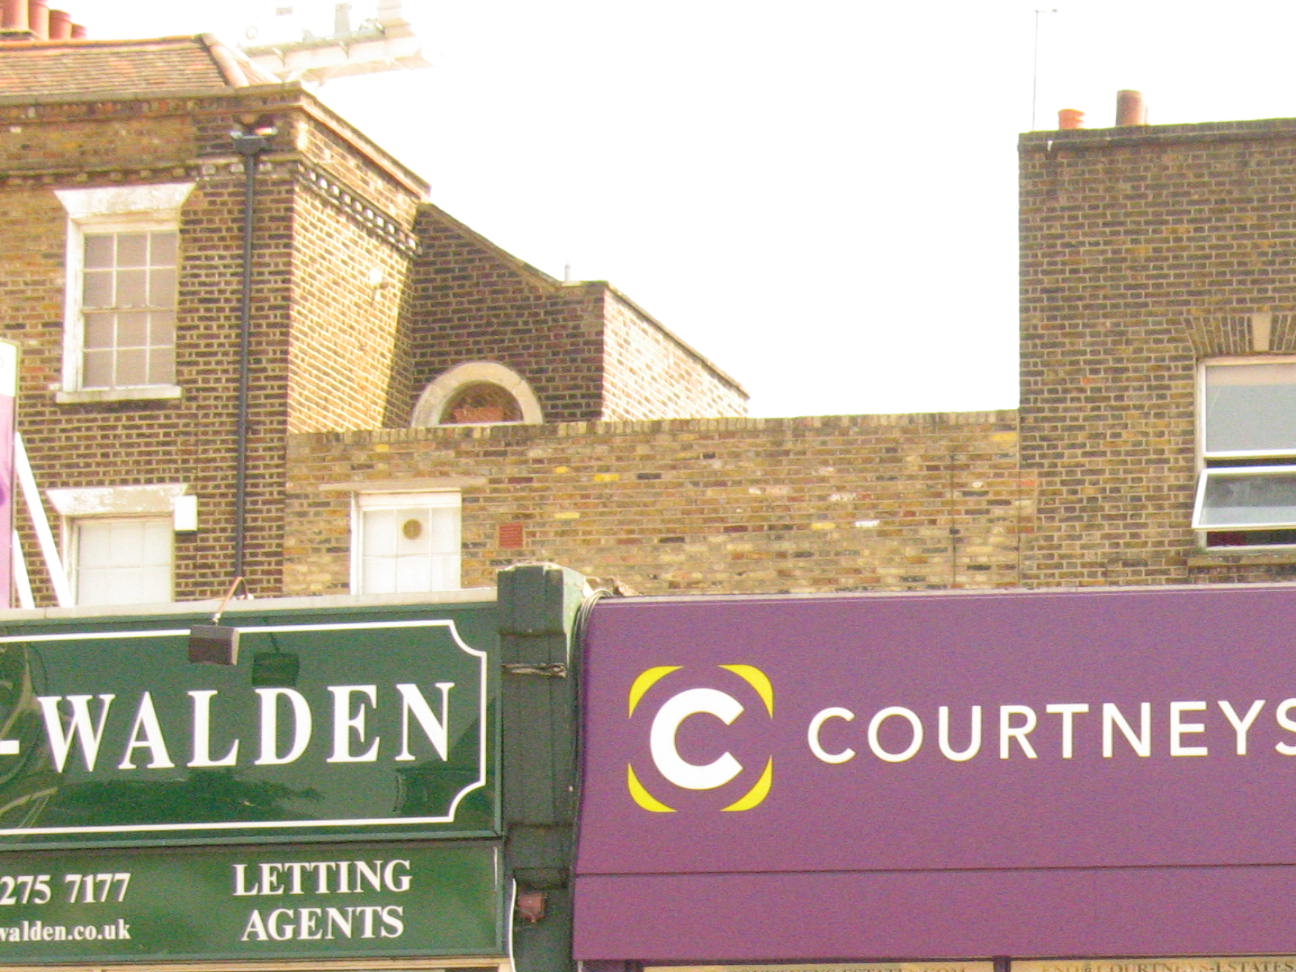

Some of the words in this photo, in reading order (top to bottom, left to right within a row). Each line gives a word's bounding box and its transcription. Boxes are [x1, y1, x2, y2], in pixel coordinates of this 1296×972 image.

[64, 872, 132, 904] 7177
[233, 859, 412, 896] LETTING
[240, 906, 404, 941] AGENTS
